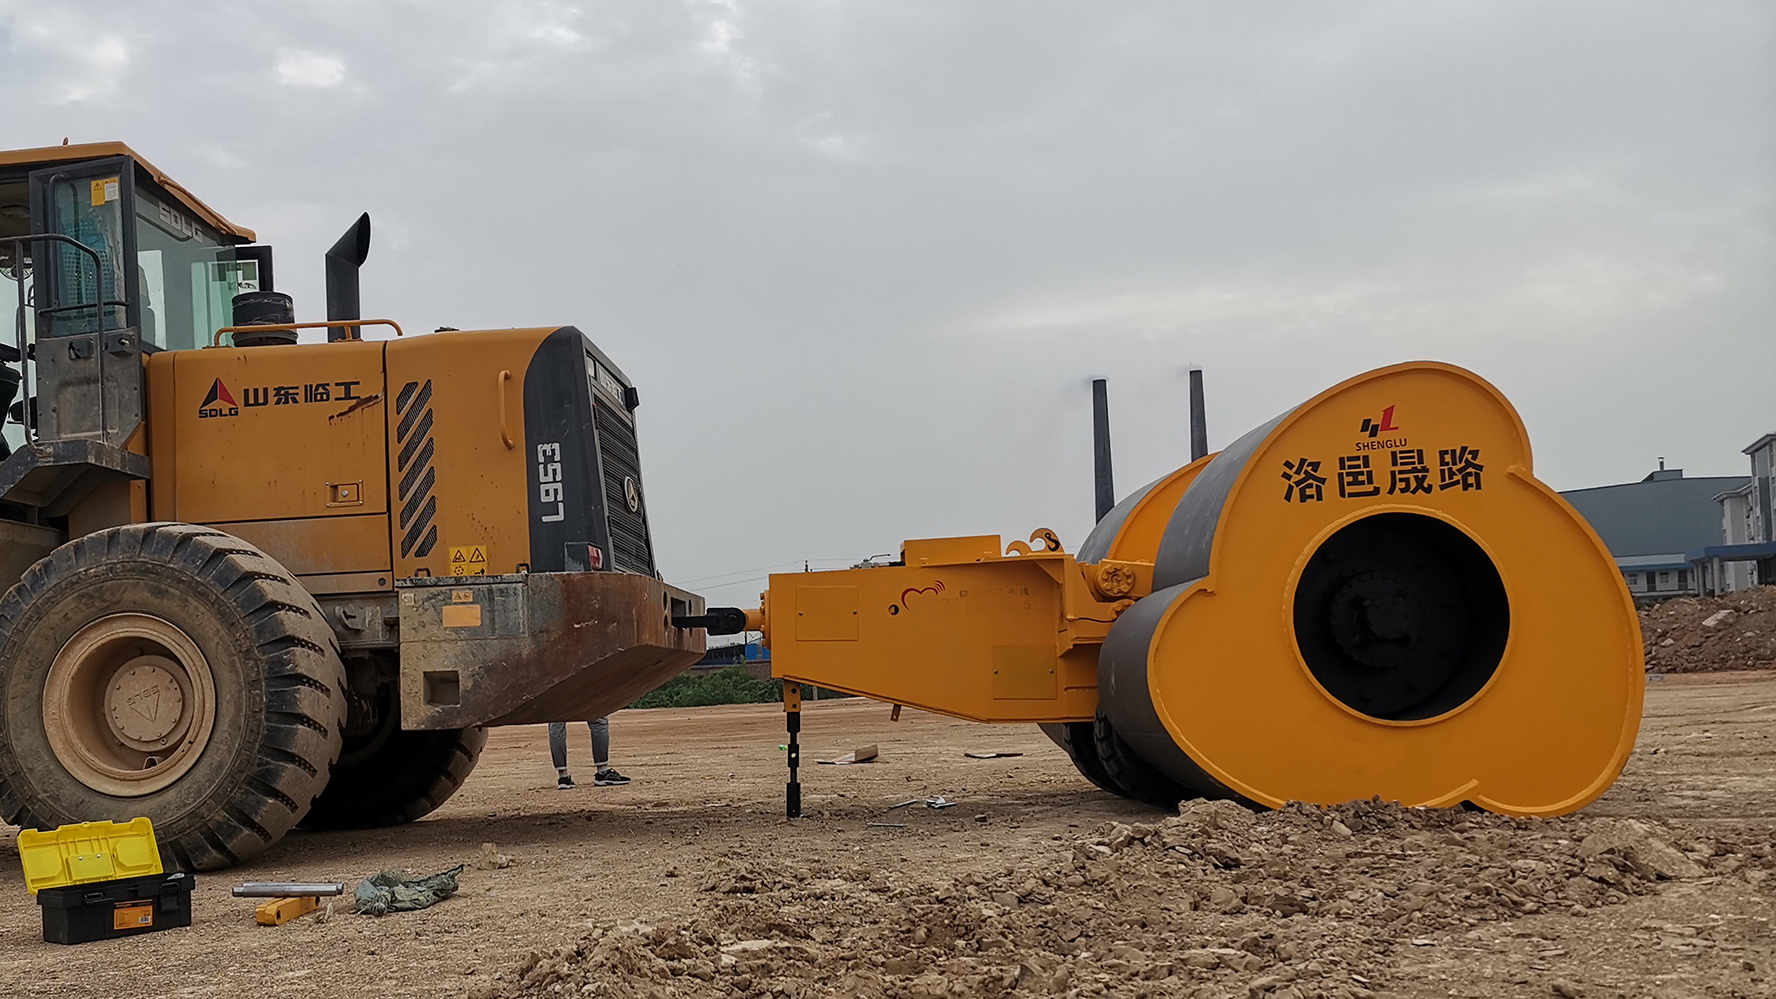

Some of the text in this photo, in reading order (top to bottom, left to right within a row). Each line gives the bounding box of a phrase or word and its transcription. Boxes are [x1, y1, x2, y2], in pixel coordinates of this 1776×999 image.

[158, 201, 204, 244] SDLG
[243, 381, 361, 408] 山东临工
[198, 407, 239, 419] SDLG
[1355, 438, 1408, 452] SHENGLU
[537, 442, 565, 523] L953
[1281, 445, 1485, 504] 洛邑晟路
